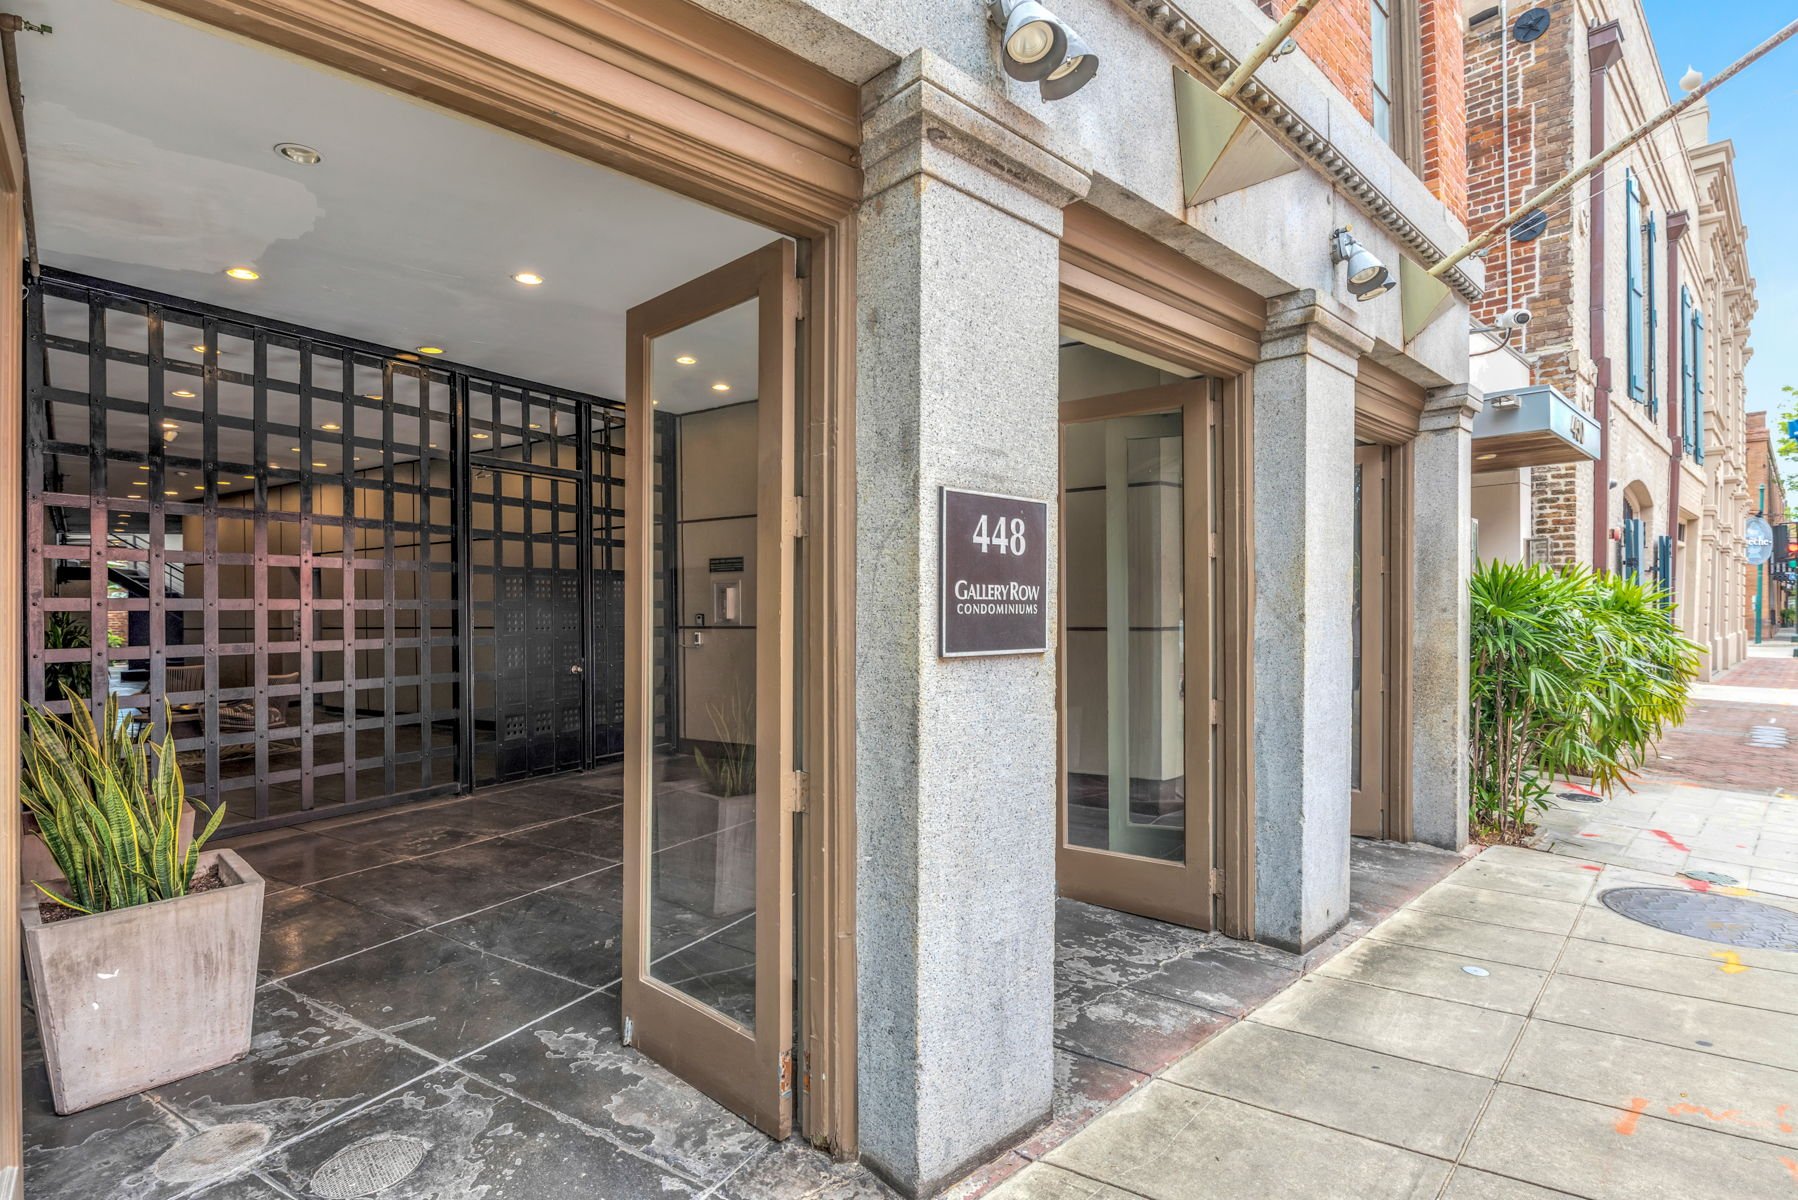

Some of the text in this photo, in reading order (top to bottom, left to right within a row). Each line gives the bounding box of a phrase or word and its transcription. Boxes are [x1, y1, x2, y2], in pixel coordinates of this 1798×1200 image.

[972, 514, 1026, 556] 448
[955, 580, 1040, 601] GALLERY ROW
[957, 603, 1038, 614] CONDOMINIUMS
